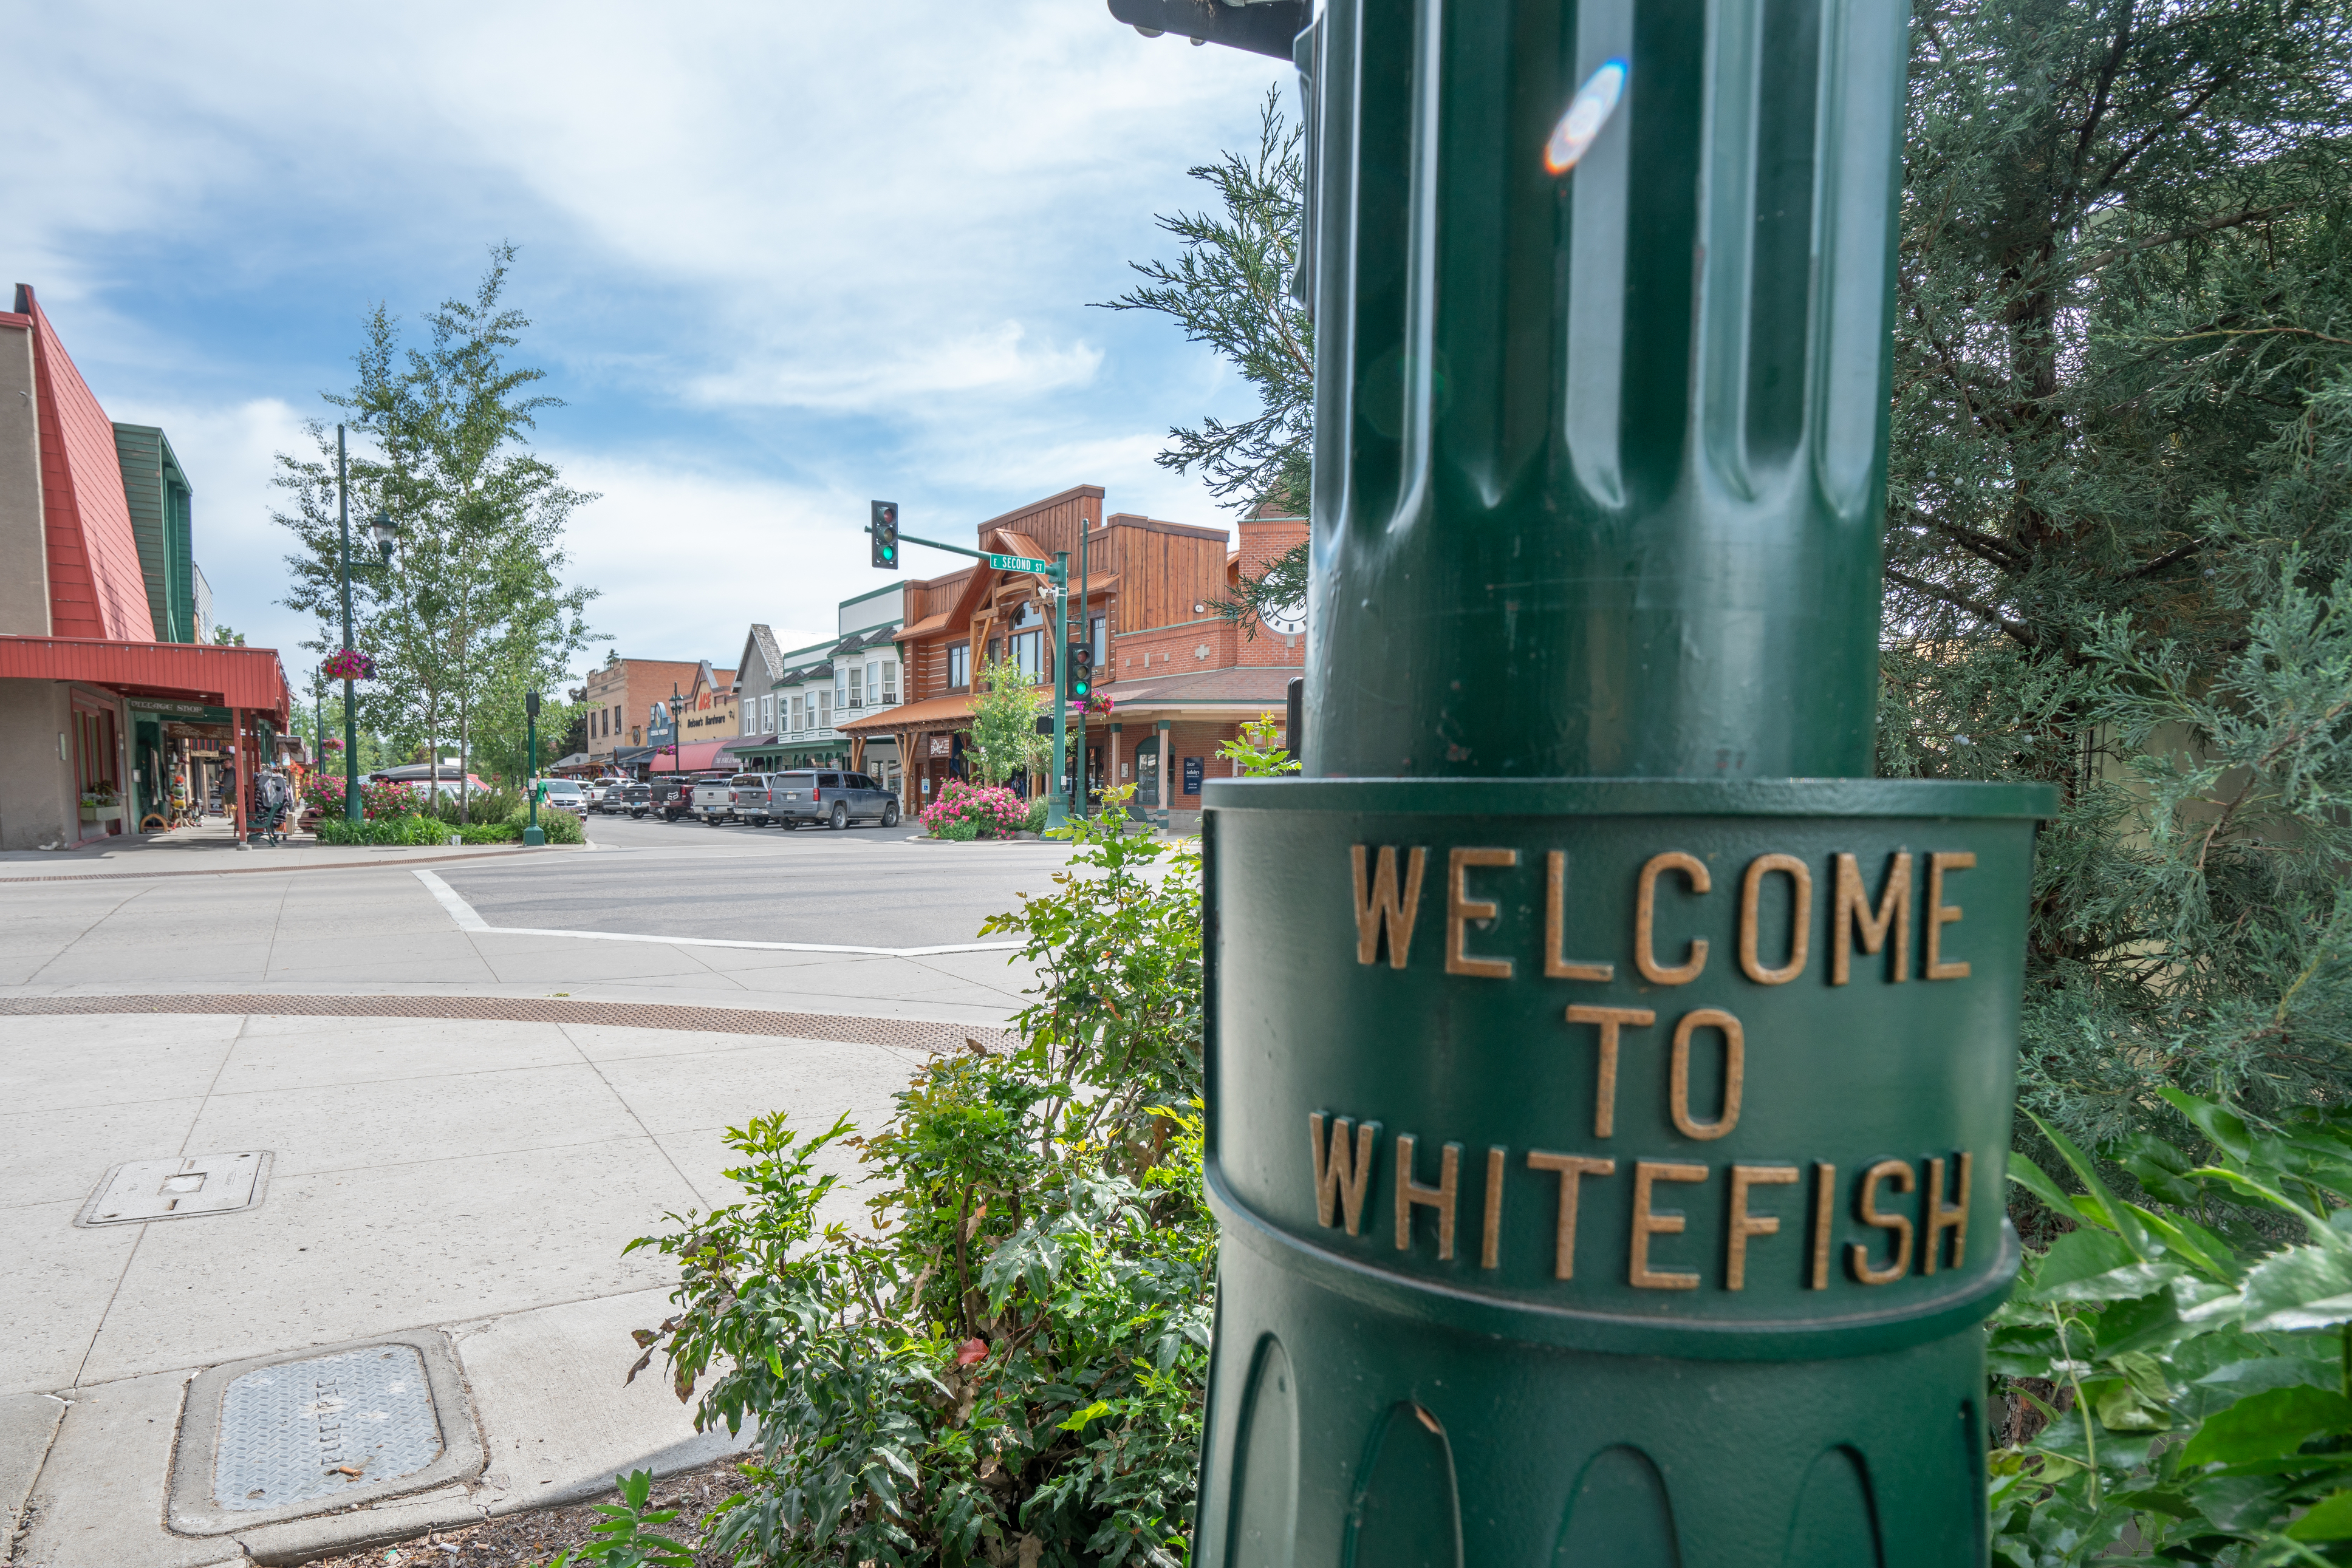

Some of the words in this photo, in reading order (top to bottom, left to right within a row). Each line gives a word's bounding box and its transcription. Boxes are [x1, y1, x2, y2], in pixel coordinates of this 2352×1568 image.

[993, 558, 997, 567] E
[1002, 556, 1031, 570] SECOND
[1035, 563, 1042, 572] ST
[131, 700, 173, 711] VILLAGE
[177, 704, 202, 713] SHOP
[698, 691, 711, 711] ACE
[687, 717, 703, 728] Nelson's
[705, 714, 725, 726] Hardware
[1350, 844, 1977, 986] WELCOME
[1565, 1004, 1745, 1142] TO
[1308, 1109, 1974, 1292] WHITEFISH
